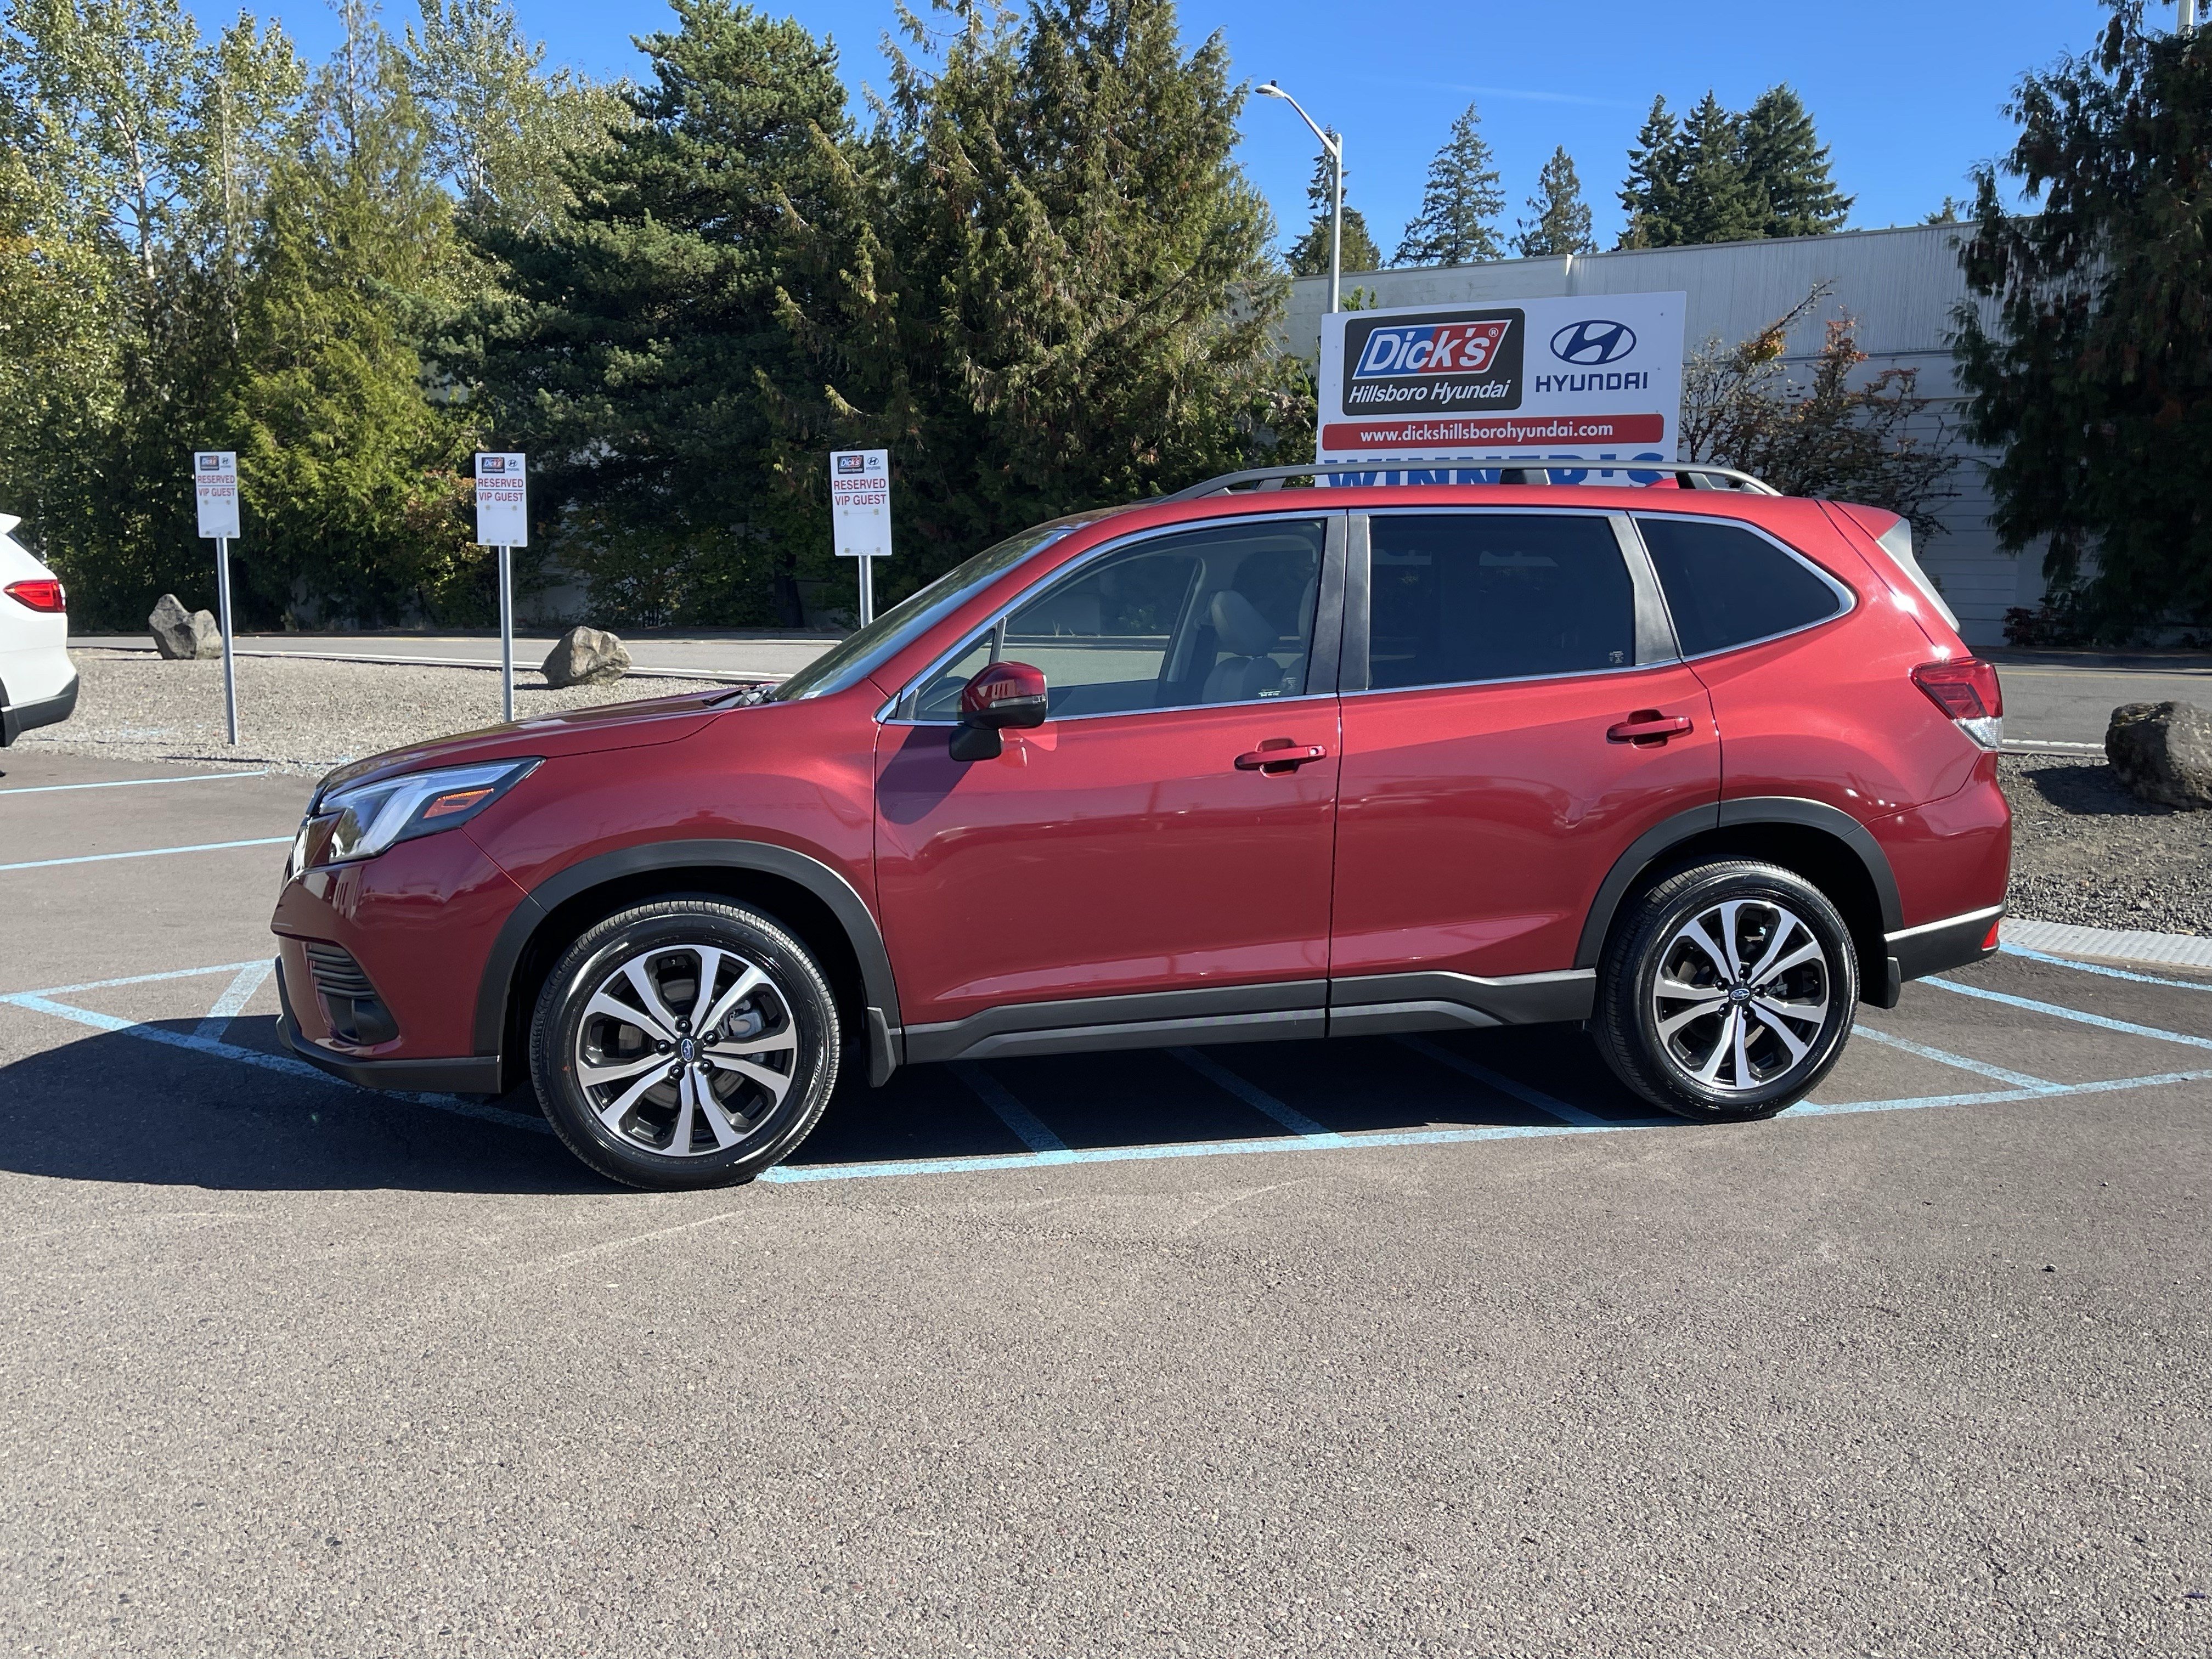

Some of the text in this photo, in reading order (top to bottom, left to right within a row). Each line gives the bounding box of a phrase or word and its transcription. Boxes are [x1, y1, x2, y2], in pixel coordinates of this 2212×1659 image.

[1363, 328, 1490, 371] Dick's
[1536, 371, 1648, 393] HYUNDAI
[1348, 379, 1511, 405] Hillsboro Hyundai
[1360, 420, 1613, 442] www.dickshillsborohyundai.com
[197, 475, 235, 484] RESERVED
[478, 478, 523, 488] RESERVED
[834, 478, 886, 490] RESERVED
[198, 488, 235, 496] VIP GUEST
[478, 492, 523, 502] VIP GUEST
[835, 494, 887, 506] VIP GUEST
